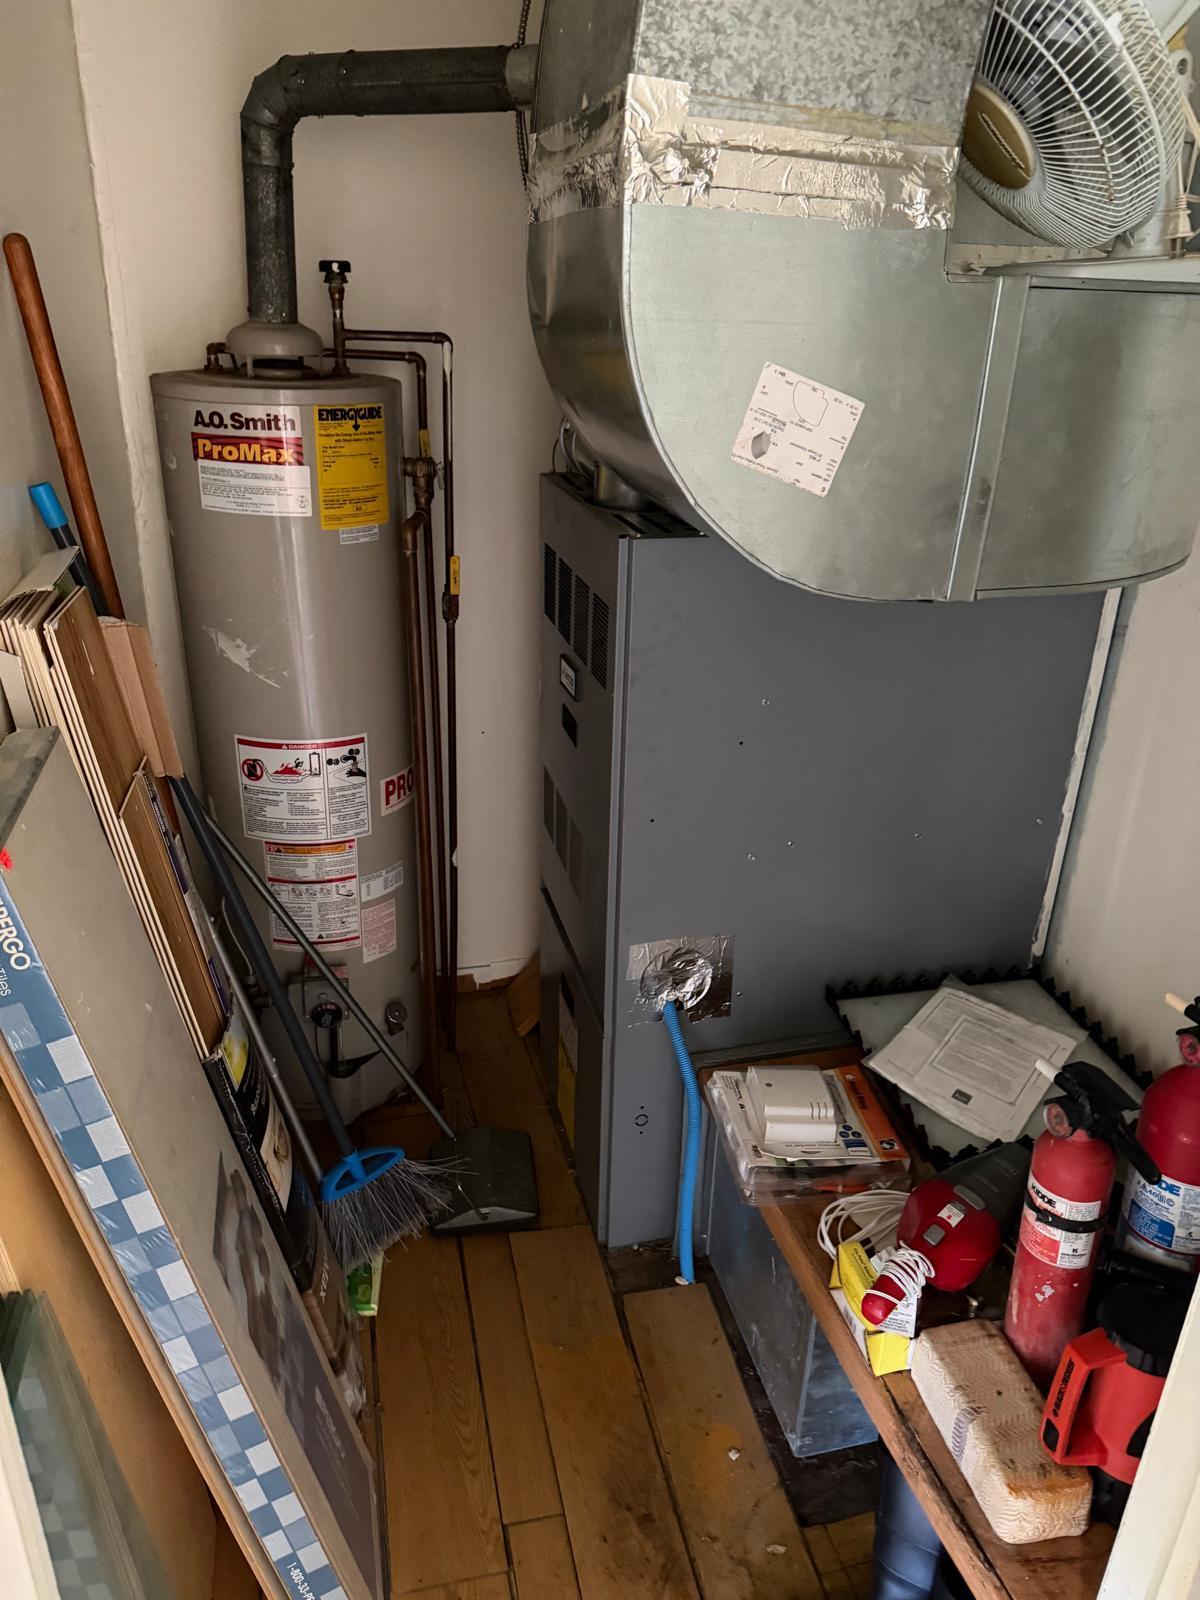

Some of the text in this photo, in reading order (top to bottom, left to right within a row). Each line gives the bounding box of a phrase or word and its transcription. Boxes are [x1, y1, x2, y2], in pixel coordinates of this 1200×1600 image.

[193, 410, 228, 430] A.O.
[230, 412, 296, 432] Smith
[317, 406, 383, 422] ENERGYGUIDE
[197, 438, 295, 464] ProMax
[1031, 1182, 1058, 1209] KIDDE
